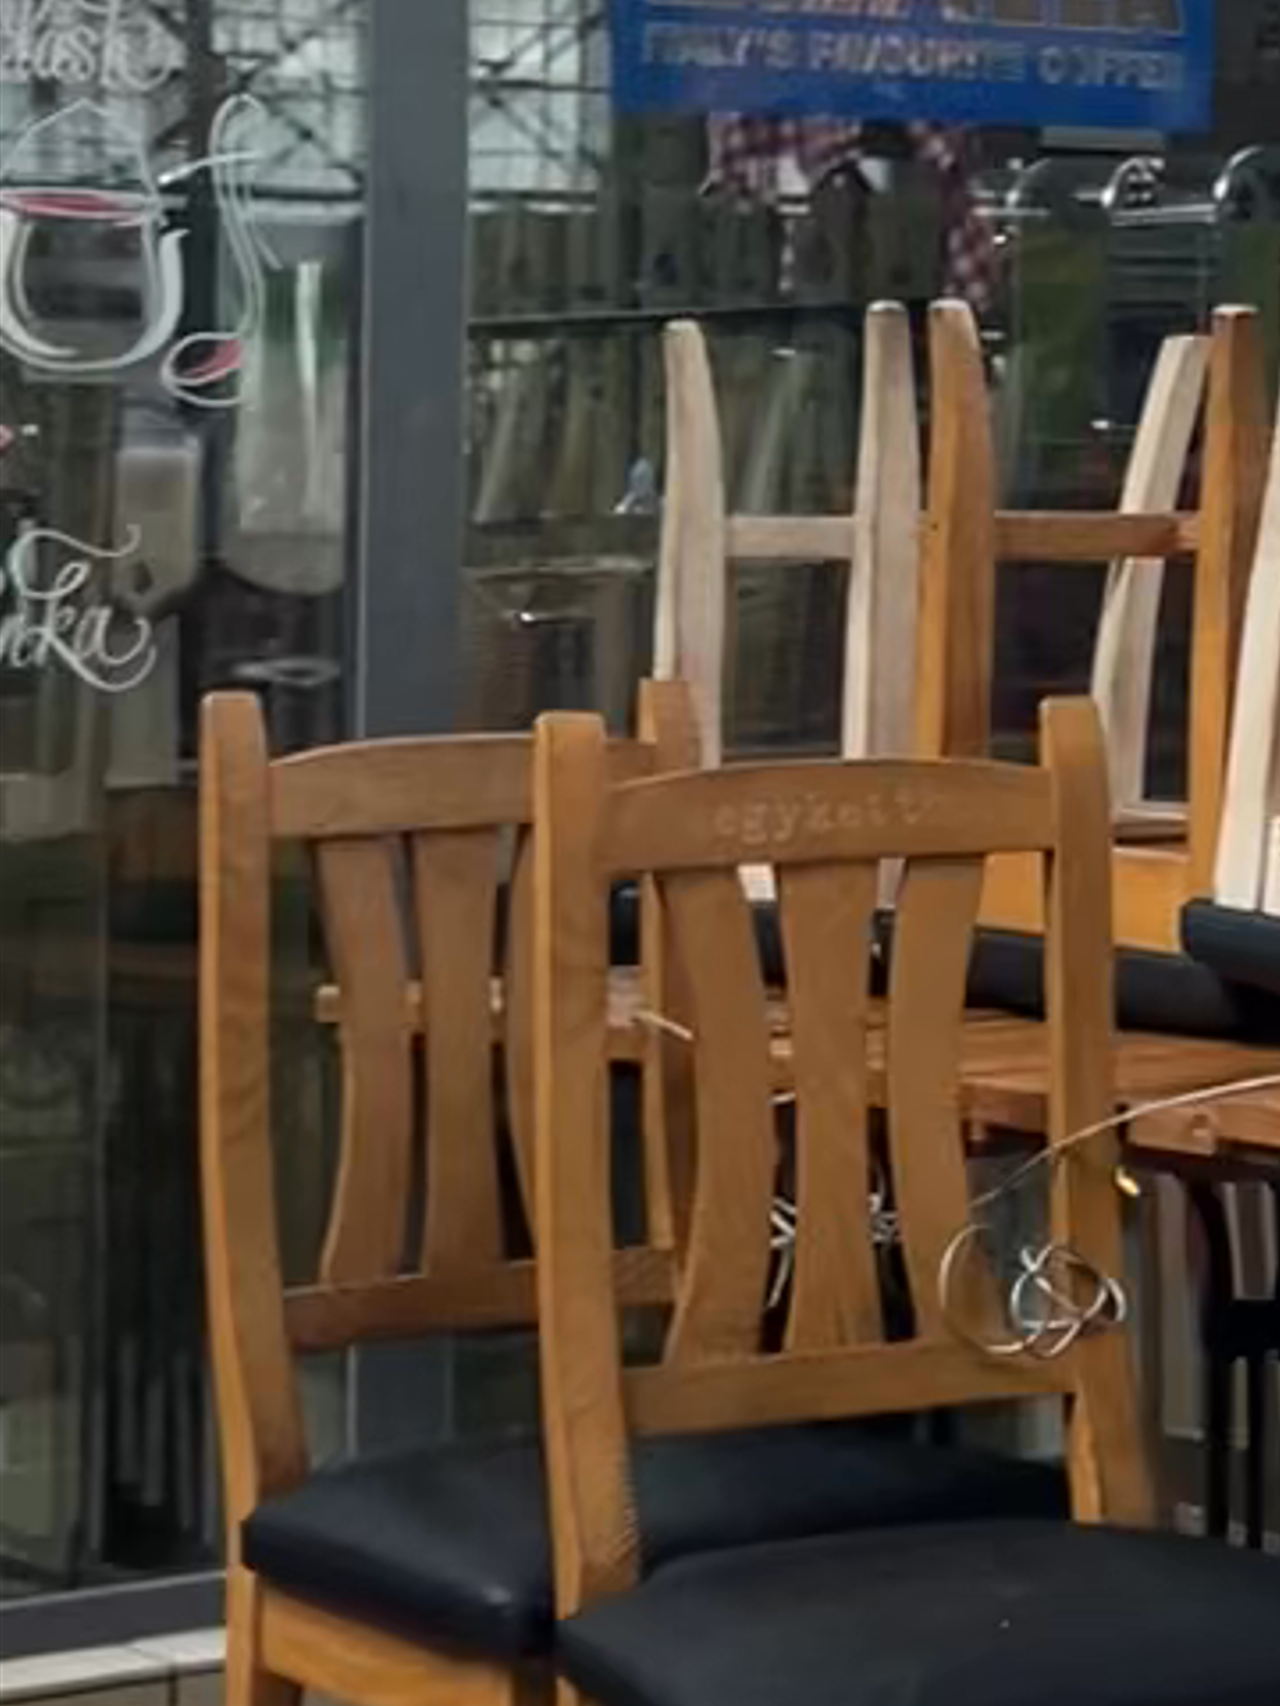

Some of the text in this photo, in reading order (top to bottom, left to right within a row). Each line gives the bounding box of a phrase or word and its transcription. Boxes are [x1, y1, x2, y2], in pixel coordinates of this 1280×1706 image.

[643, 20, 1186, 92] ITALY'S FAVOURITE COFFEE
